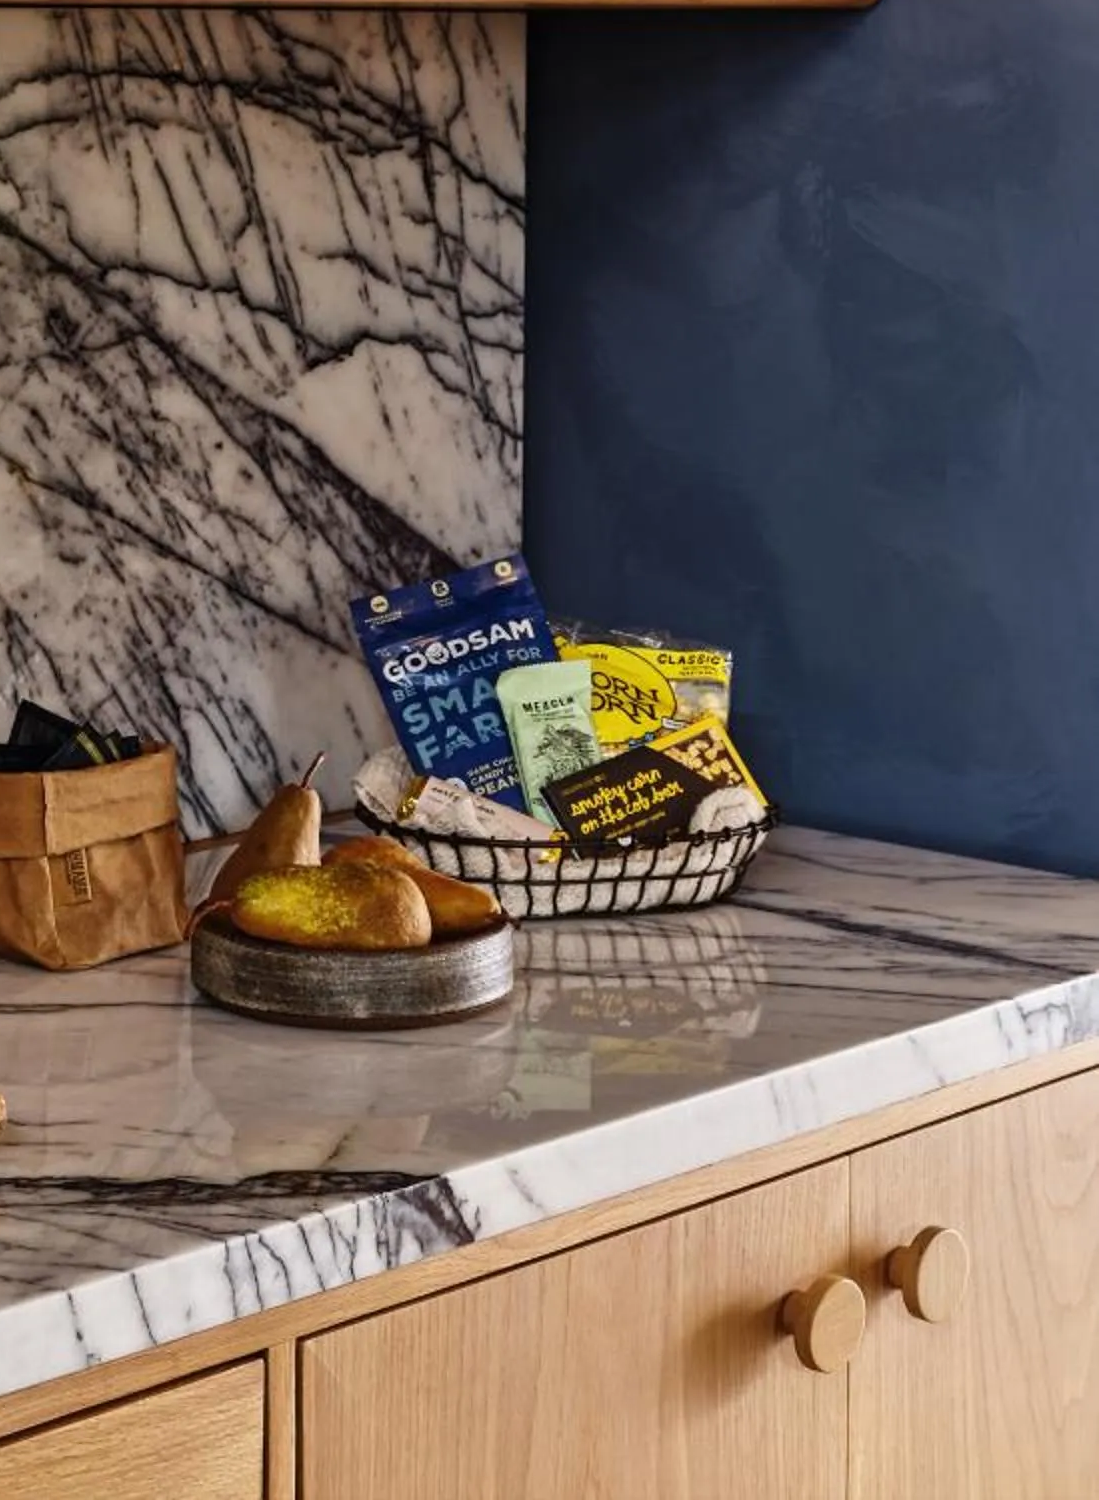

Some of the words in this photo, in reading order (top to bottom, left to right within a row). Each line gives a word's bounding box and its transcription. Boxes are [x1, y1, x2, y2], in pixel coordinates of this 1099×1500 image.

[383, 618, 536, 684] GOODSAM
[656, 652, 721, 666] CLASSIC
[392, 685, 418, 703] BE
[423, 671, 450, 690] AN
[457, 651, 500, 677] ALLY
[507, 647, 543, 662] FOR
[591, 670, 660, 704] ORN
[402, 677, 497, 735] SMA
[591, 691, 659, 725] ORN
[414, 711, 506, 770] FAR
[470, 769, 505, 787] CANDY
[474, 773, 521, 796] PEAN
[579, 817, 600, 836] on
[598, 804, 627, 825] the
[625, 792, 650, 815] cob
